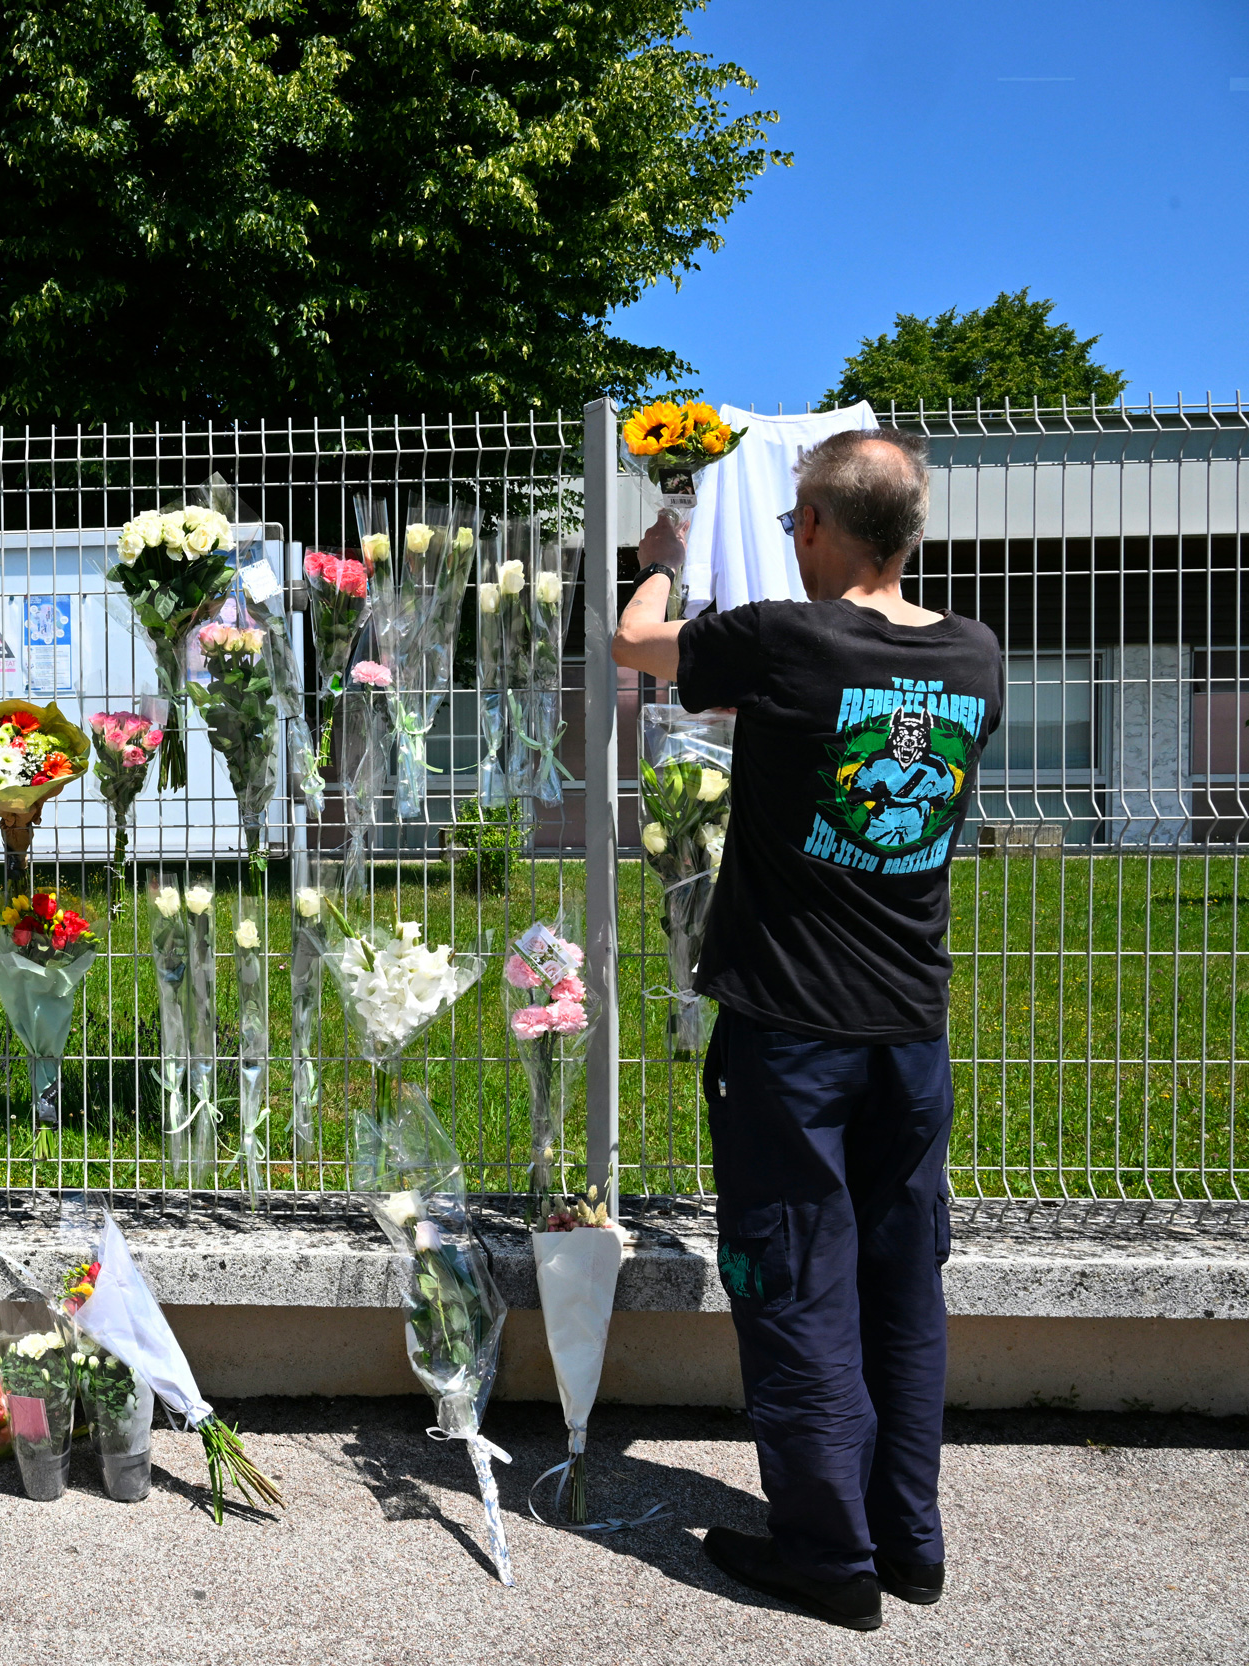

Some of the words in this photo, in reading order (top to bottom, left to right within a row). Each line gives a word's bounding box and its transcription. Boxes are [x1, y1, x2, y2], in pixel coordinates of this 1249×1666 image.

[891, 677, 944, 692] TEAM
[836, 688, 924, 734] FREDERIC
[927, 693, 985, 742] RABERT
[803, 812, 880, 873] JIU-JITSU
[881, 822, 955, 875] BRESILIEN
